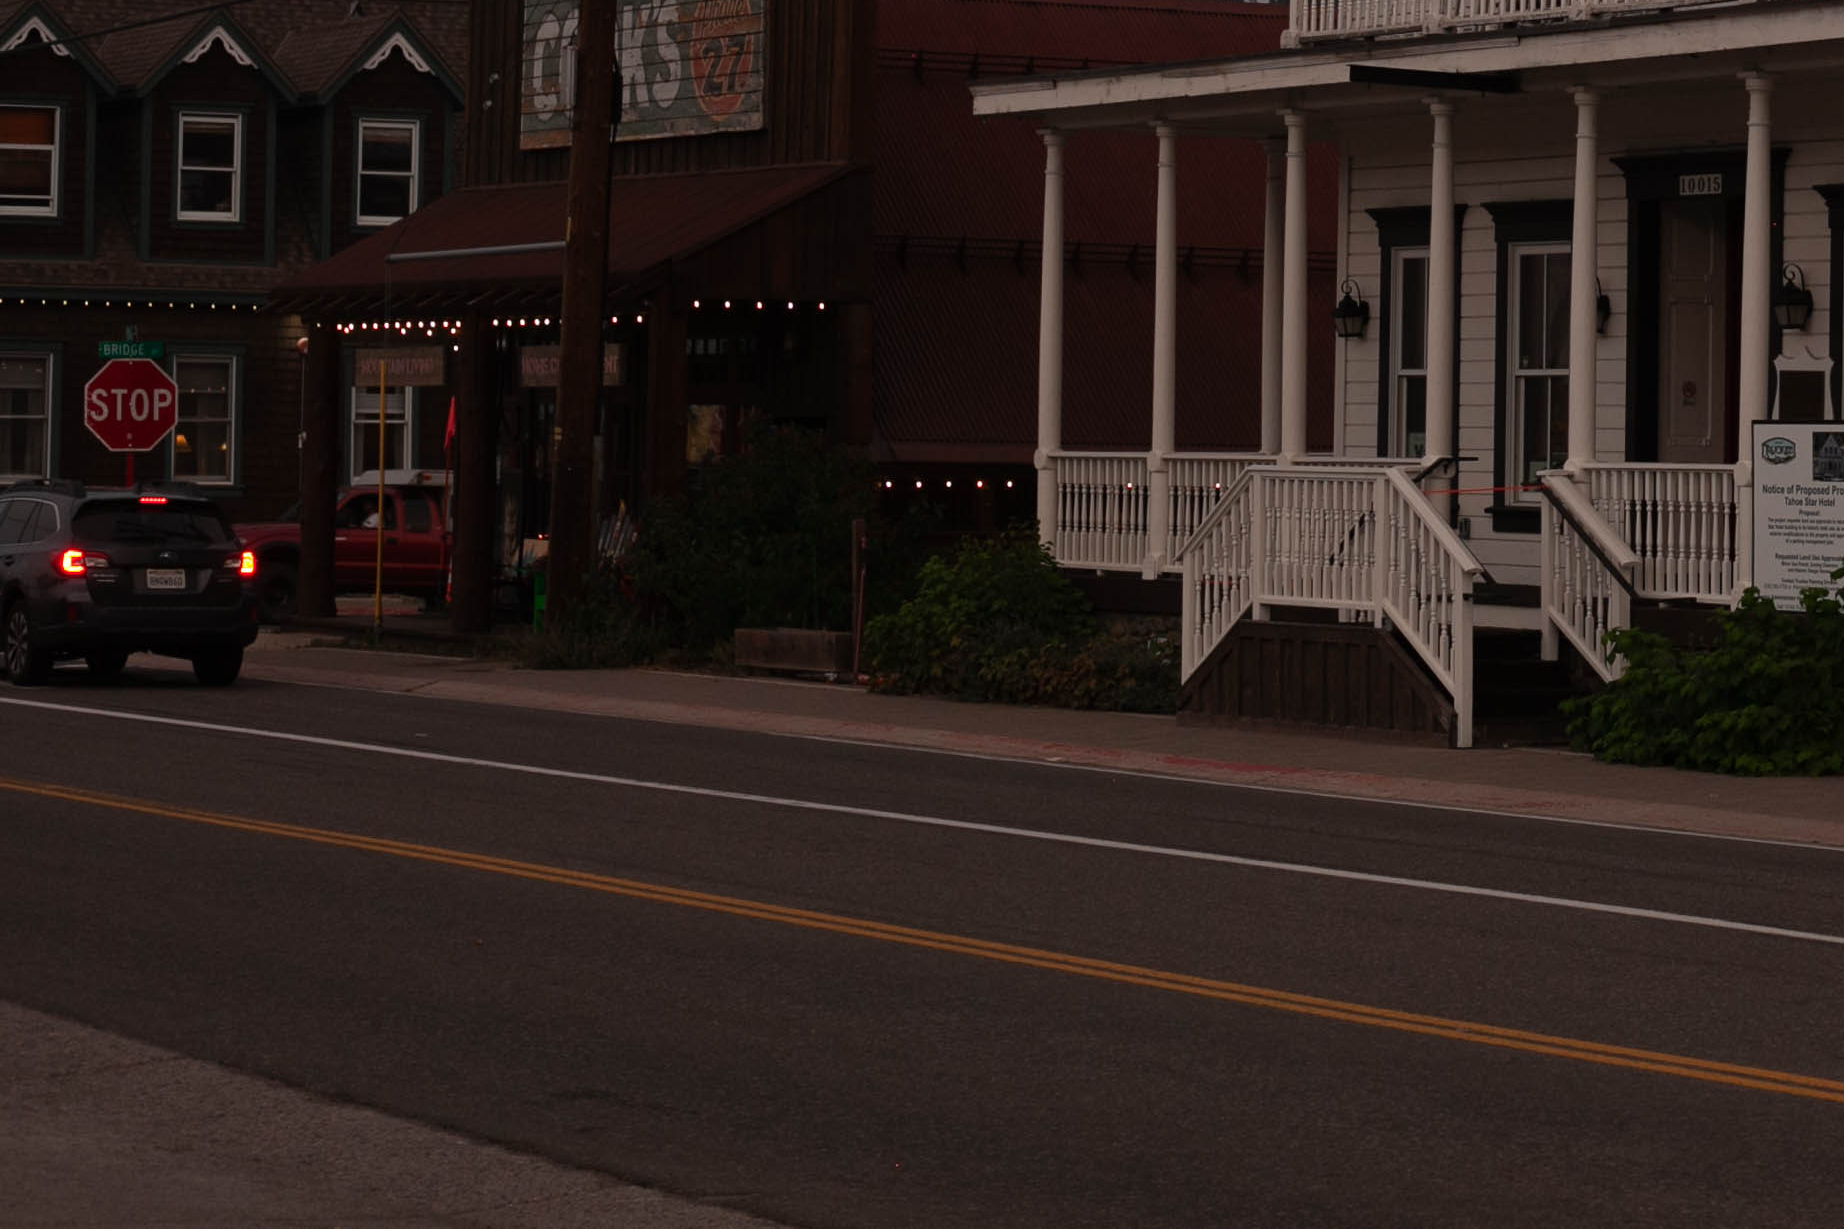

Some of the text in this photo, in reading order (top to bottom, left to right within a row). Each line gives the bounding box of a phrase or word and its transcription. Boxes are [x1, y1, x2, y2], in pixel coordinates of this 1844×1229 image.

[703, 34, 746, 95] 27
[1681, 176, 1720, 193] 10015
[103, 343, 145, 356] BRIDGE
[89, 387, 173, 422] STOP
[1762, 484, 1785, 495] Notice
[1787, 484, 1795, 495] of
[1796, 485, 1830, 497] Proposed
[1784, 497, 1836, 508] Tahoe Star Hotel
